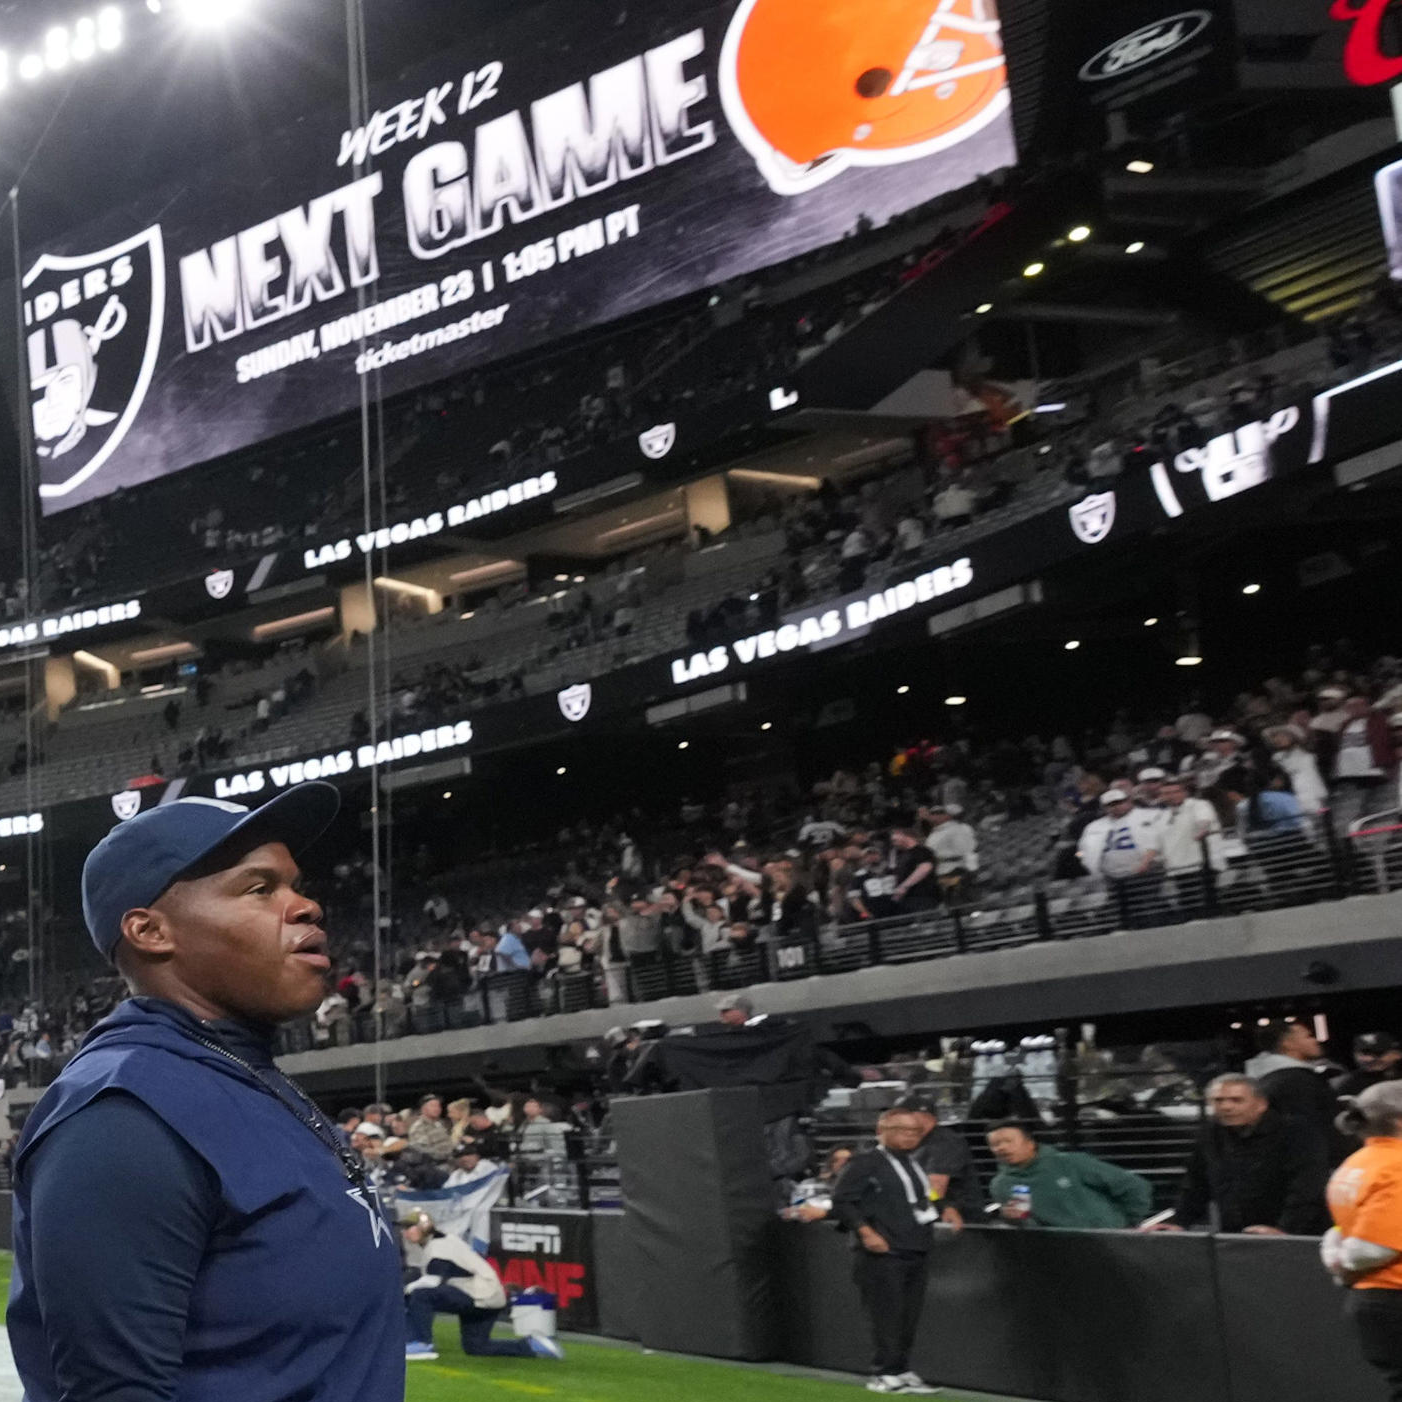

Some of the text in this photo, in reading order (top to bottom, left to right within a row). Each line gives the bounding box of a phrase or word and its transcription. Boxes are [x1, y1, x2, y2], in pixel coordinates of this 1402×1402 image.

[336, 61, 503, 166] WEEK 12
[179, 28, 716, 353] NEXT GAME
[23, 255, 133, 326] IDERS
[235, 329, 321, 383] SUNDAY,
[320, 283, 440, 352] NOVEMBER
[440, 269, 474, 307] 23
[501, 237, 558, 283] 1:05
[557, 218, 606, 263] PM
[605, 203, 641, 246] PT
[355, 303, 510, 374] ticketmaster
[304, 471, 558, 569] LAS VEGAS RAIDERS
[42, 600, 141, 637] RAIDERS
[671, 558, 973, 684] LAS VEGAS RAIDERS
[214, 720, 473, 799] LAS VEGAS RAIDERS
